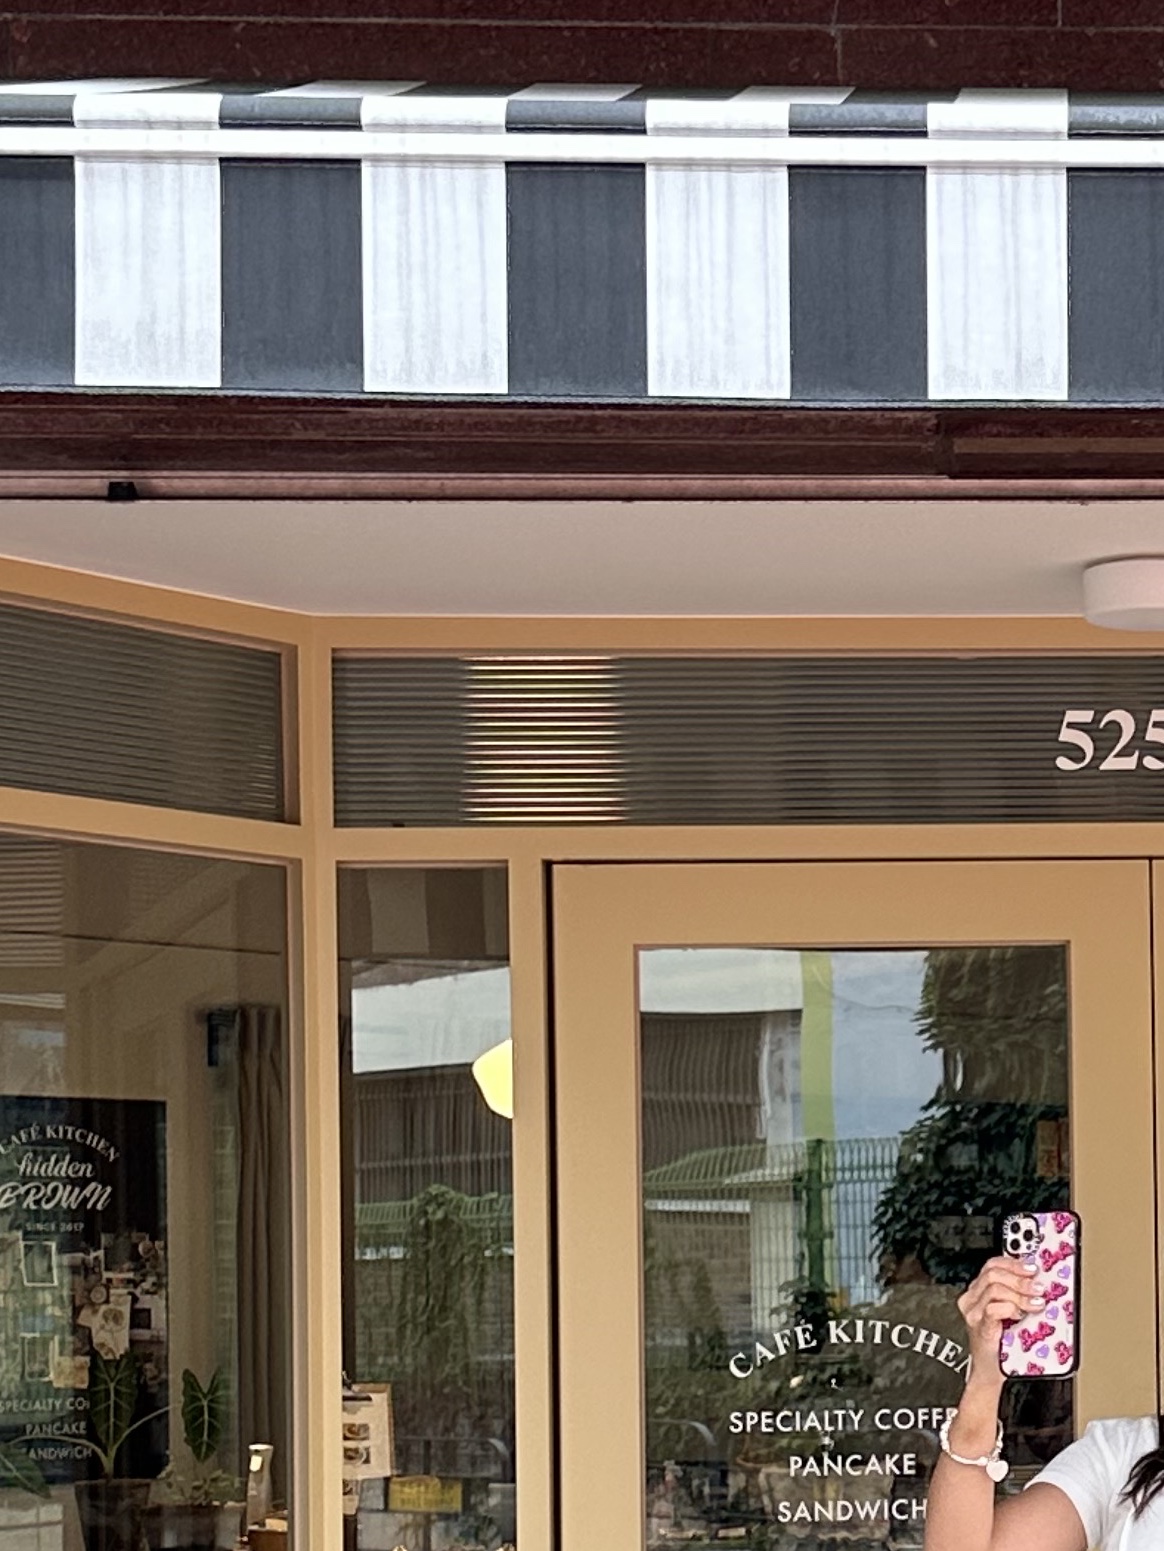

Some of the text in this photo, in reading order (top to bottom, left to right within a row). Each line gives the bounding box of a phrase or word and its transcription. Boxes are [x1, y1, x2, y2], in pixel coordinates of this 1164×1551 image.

[46, 1125, 119, 1162] KITCHEN
[15, 1151, 95, 1178] hidden
[0, 1181, 113, 1211] BROWN
[728, 1319, 817, 1379] CAFÉ
[25, 1421, 88, 1436] PANCAKE
[729, 1408, 865, 1434] SPECIALTY
[28, 1446, 93, 1460] ANDWICH
[789, 1453, 917, 1478] PANCAKE
[777, 1498, 927, 1523] SANDWICH
